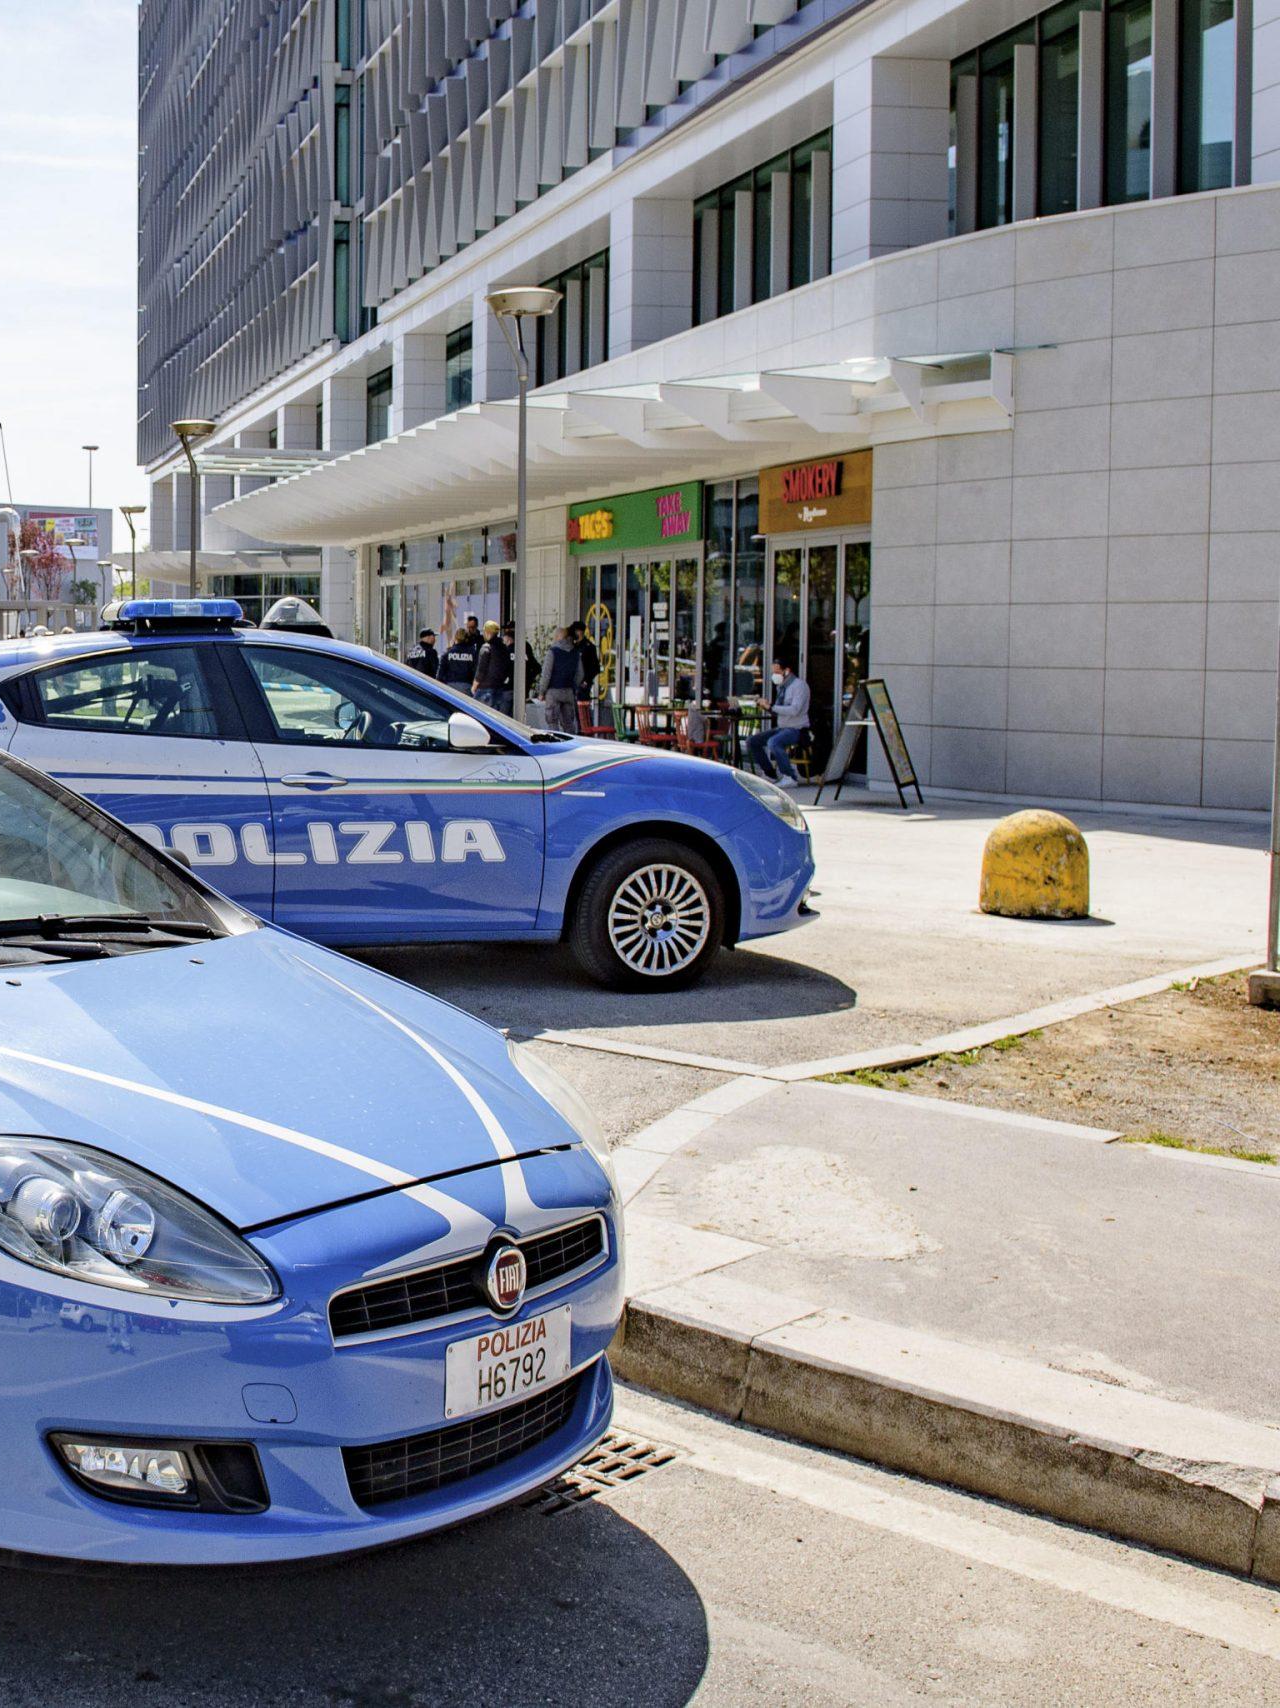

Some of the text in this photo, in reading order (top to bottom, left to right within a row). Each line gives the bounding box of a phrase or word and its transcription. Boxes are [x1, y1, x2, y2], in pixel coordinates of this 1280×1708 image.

[783, 462, 840, 504] SMOKERY
[656, 491, 681, 517] TAKE
[662, 511, 691, 538] AWAY
[448, 652, 473, 661] POLIZIA
[126, 821, 507, 865] OLIZIA
[499, 1264, 520, 1294] FIAT
[477, 1317, 546, 1361] POLIZIA
[477, 1347, 547, 1405] H6792
